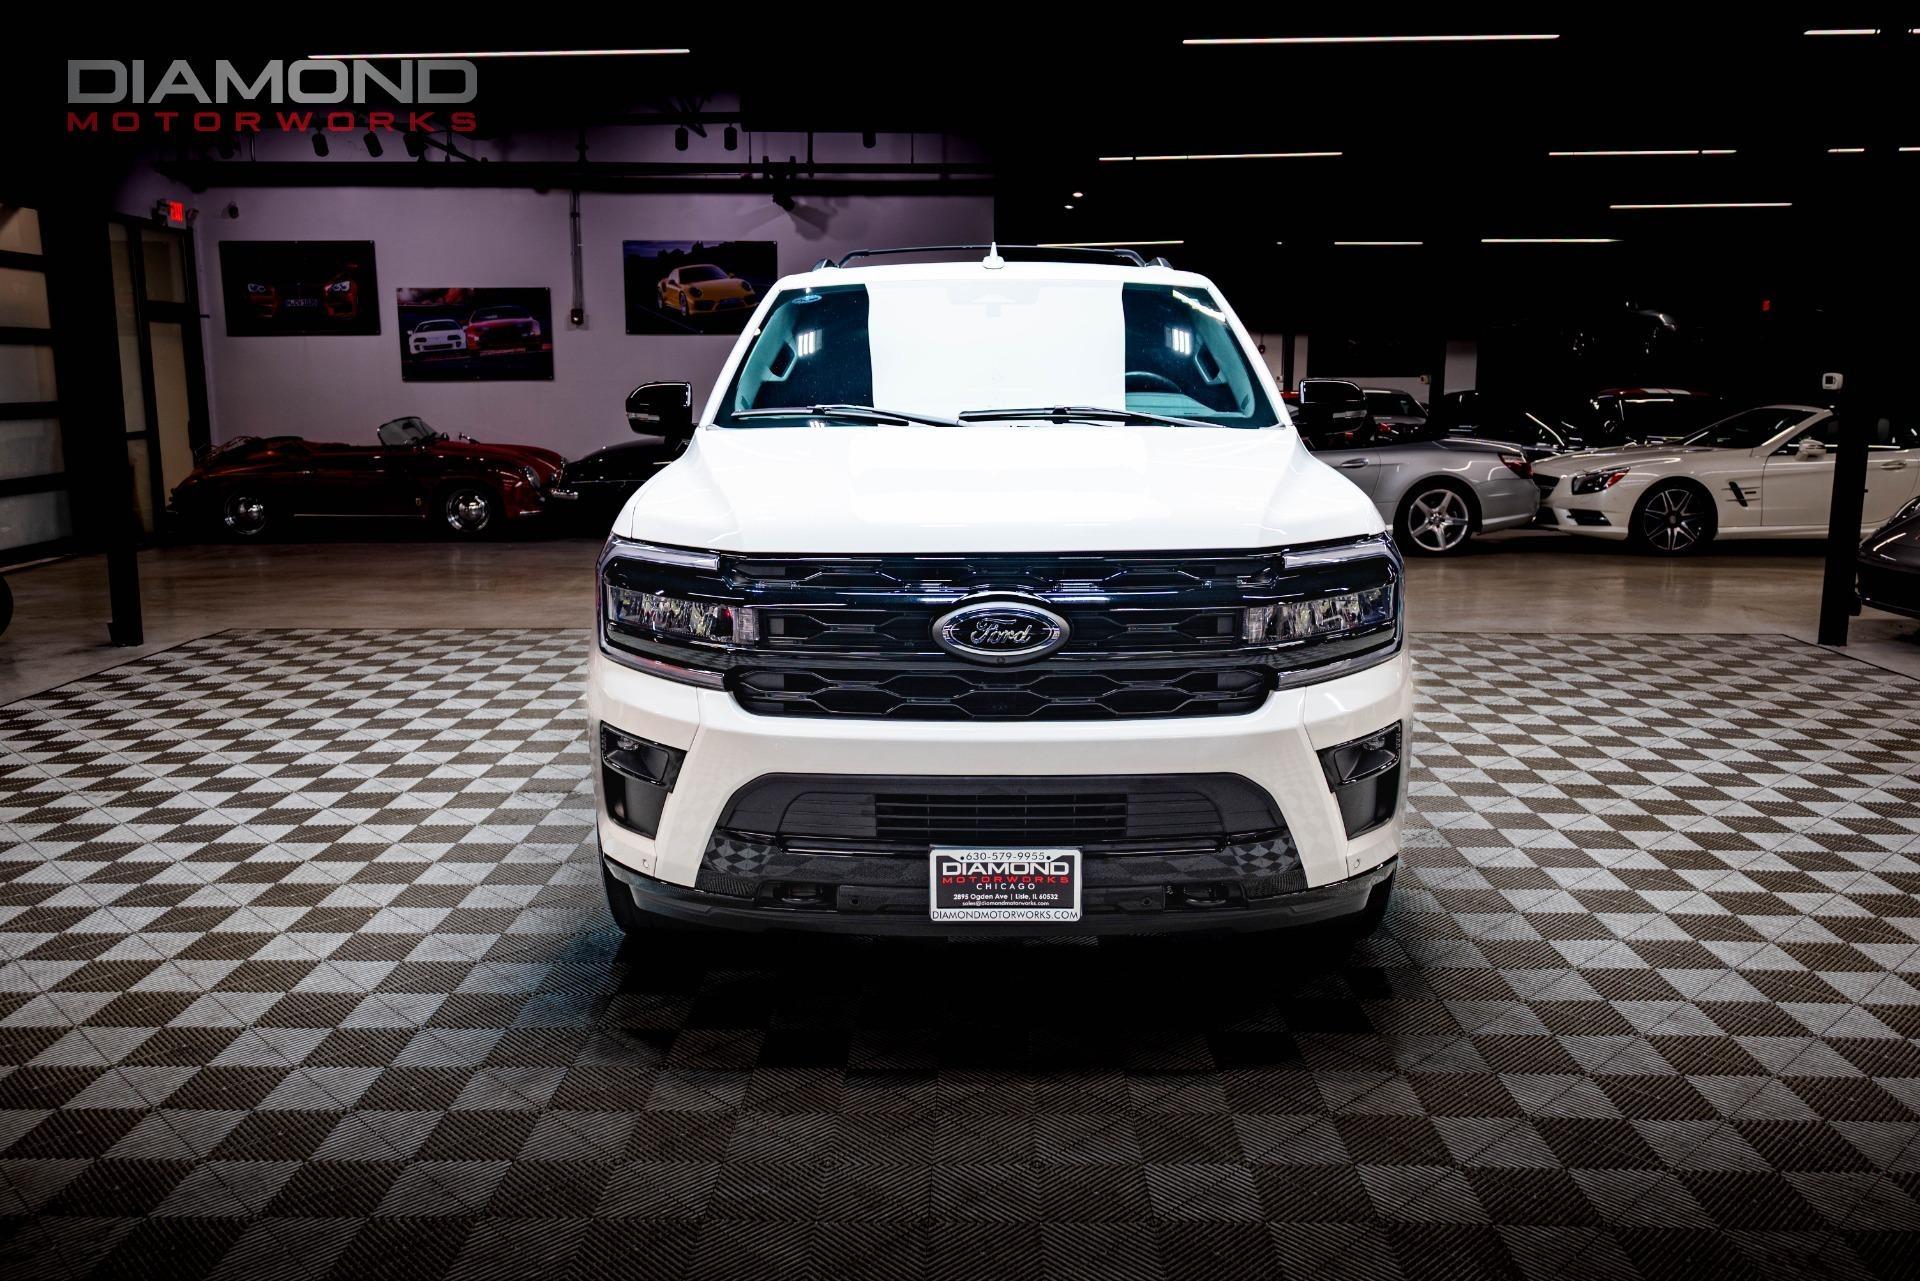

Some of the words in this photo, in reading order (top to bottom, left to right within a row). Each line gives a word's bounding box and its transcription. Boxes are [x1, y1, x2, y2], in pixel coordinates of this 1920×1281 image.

[970, 617, 1032, 644] Ford
[965, 851, 1045, 861] 630-579-9955
[942, 862, 1069, 876] DIAMOND
[942, 876, 1069, 885] MOTORWORKS
[970, 893, 994, 901] Ogden
[932, 910, 1079, 920] DIAMONDMOTORWORKS.COM
